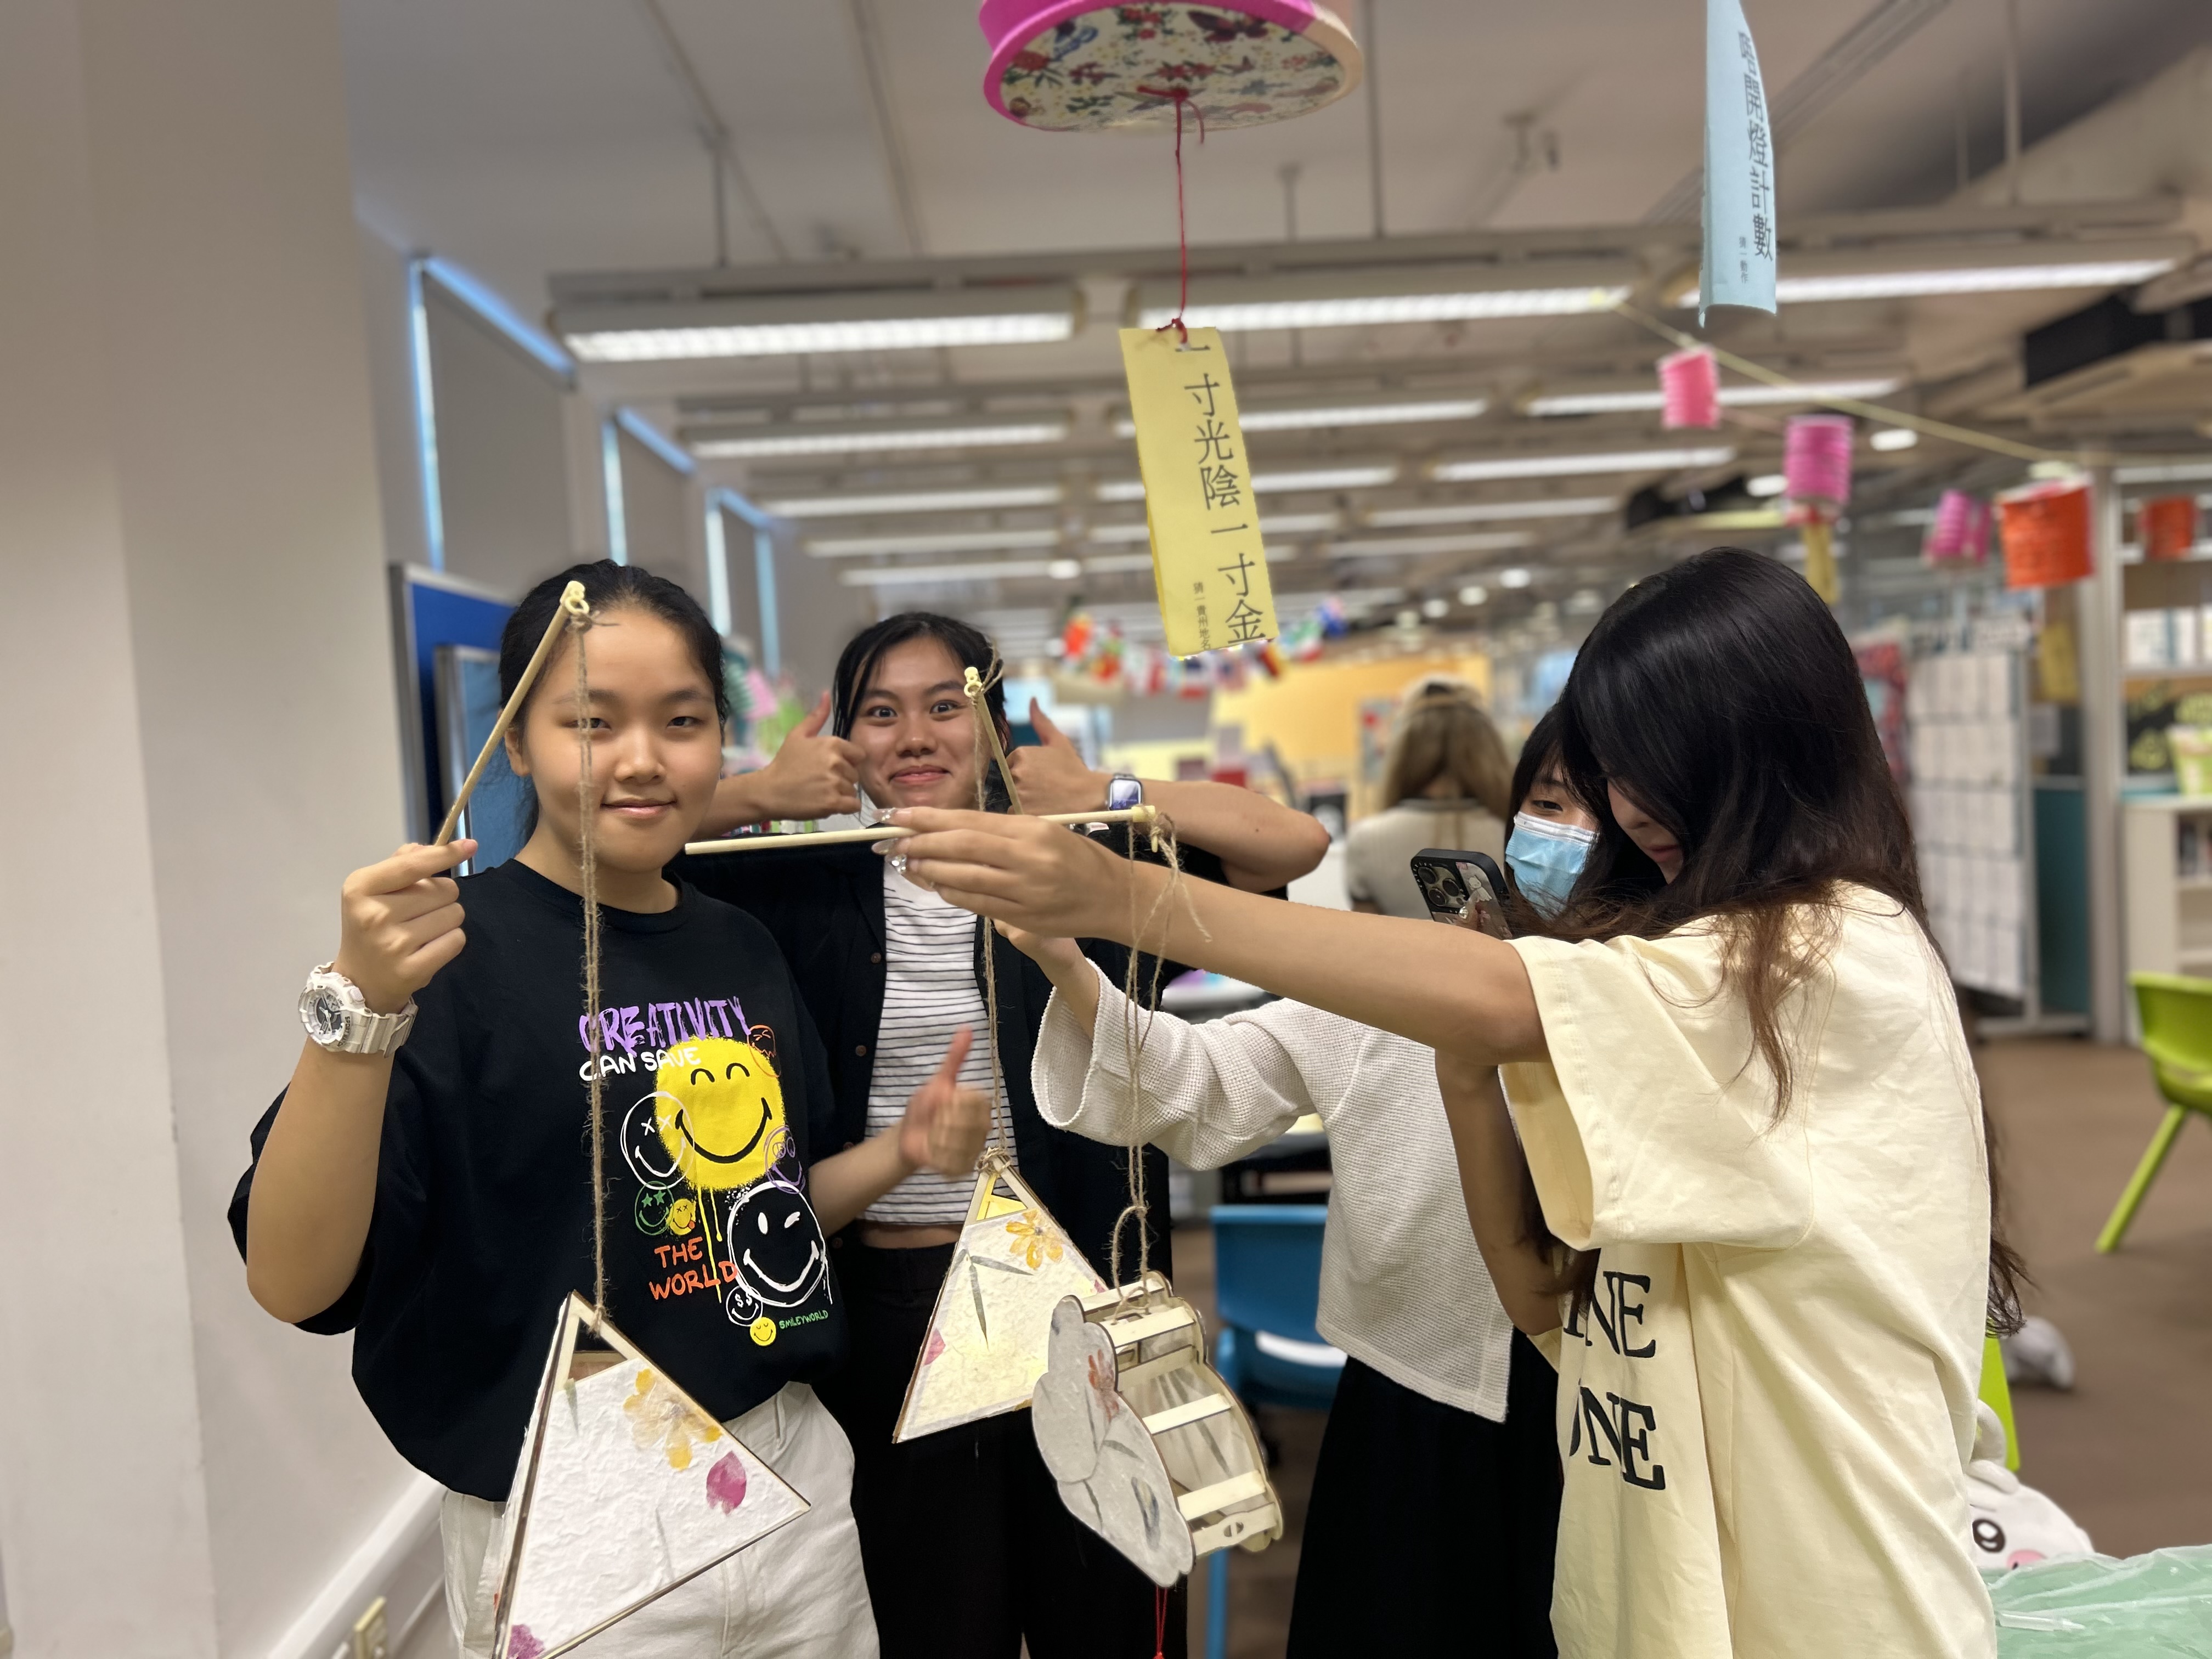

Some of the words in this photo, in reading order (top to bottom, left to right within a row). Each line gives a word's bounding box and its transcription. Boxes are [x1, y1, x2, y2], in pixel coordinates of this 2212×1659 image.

[1175, 344, 1266, 645] 一寸光陰一寸金
[579, 996, 751, 1058] CREATIVITY
[579, 1053, 636, 1081] CAN
[641, 1047, 702, 1071] SAVE
[654, 1237, 703, 1268] THE
[649, 1261, 737, 1300] WORLD
[778, 1310, 828, 1330] SMILEYWORLD
